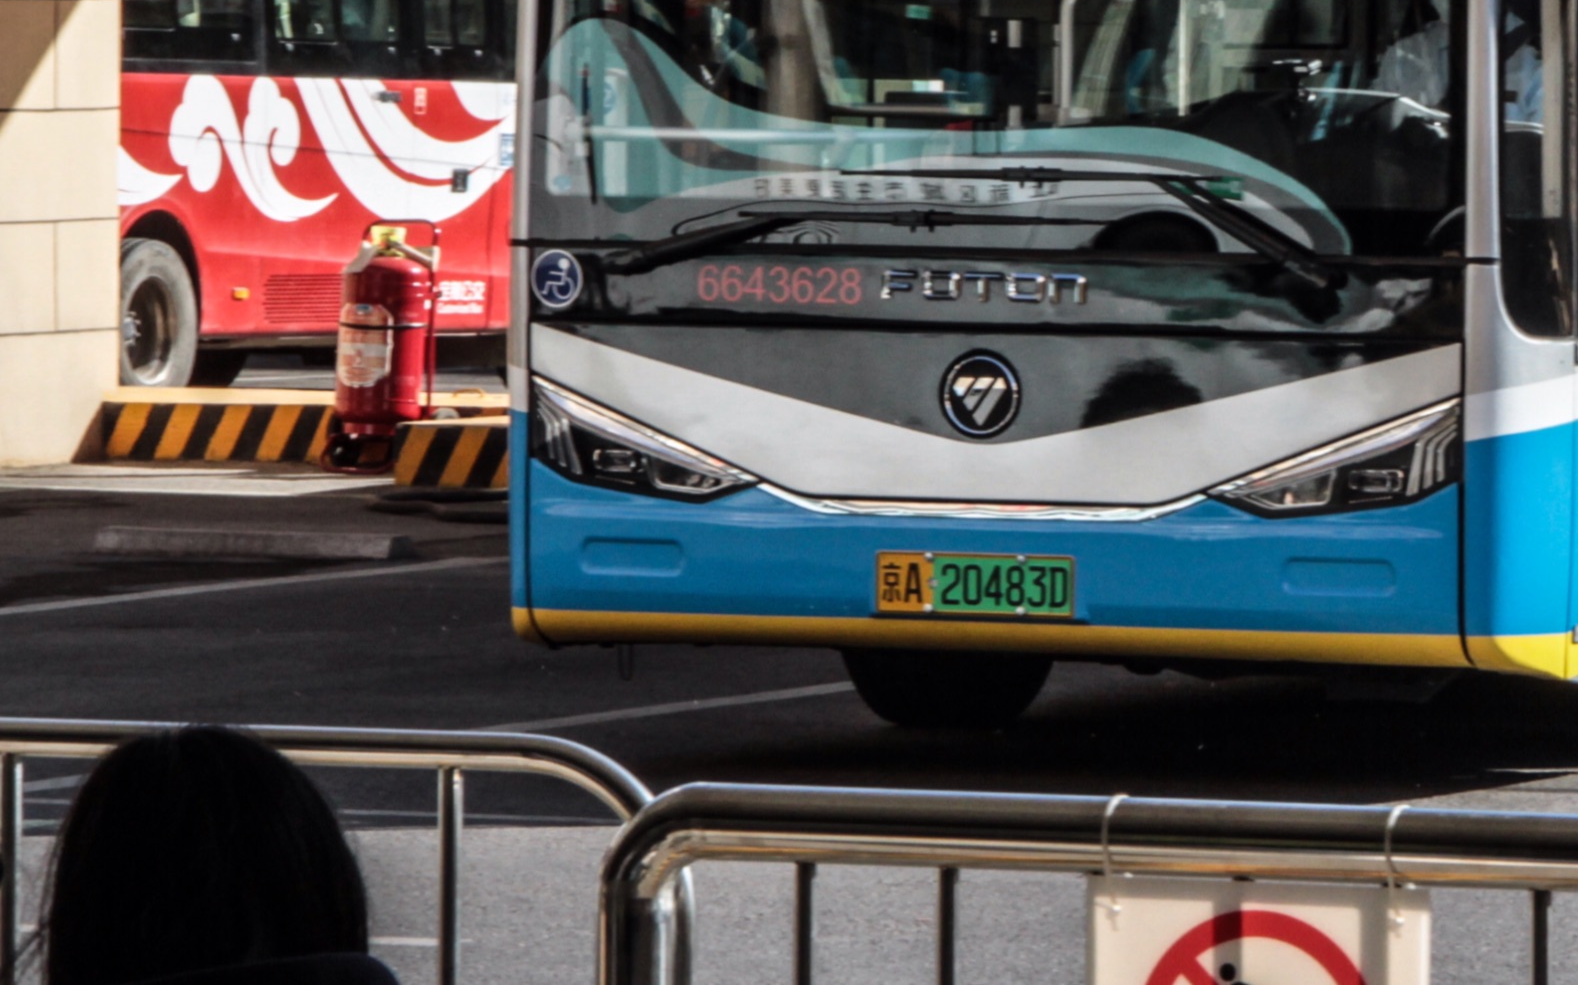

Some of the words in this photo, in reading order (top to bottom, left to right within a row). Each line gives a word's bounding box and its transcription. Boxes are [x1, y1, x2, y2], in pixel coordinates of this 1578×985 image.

[697, 264, 863, 305] 6643628
[880, 269, 1088, 305] FOTON
[882, 562, 923, 603] 京A
[940, 563, 1068, 608] 20483D
